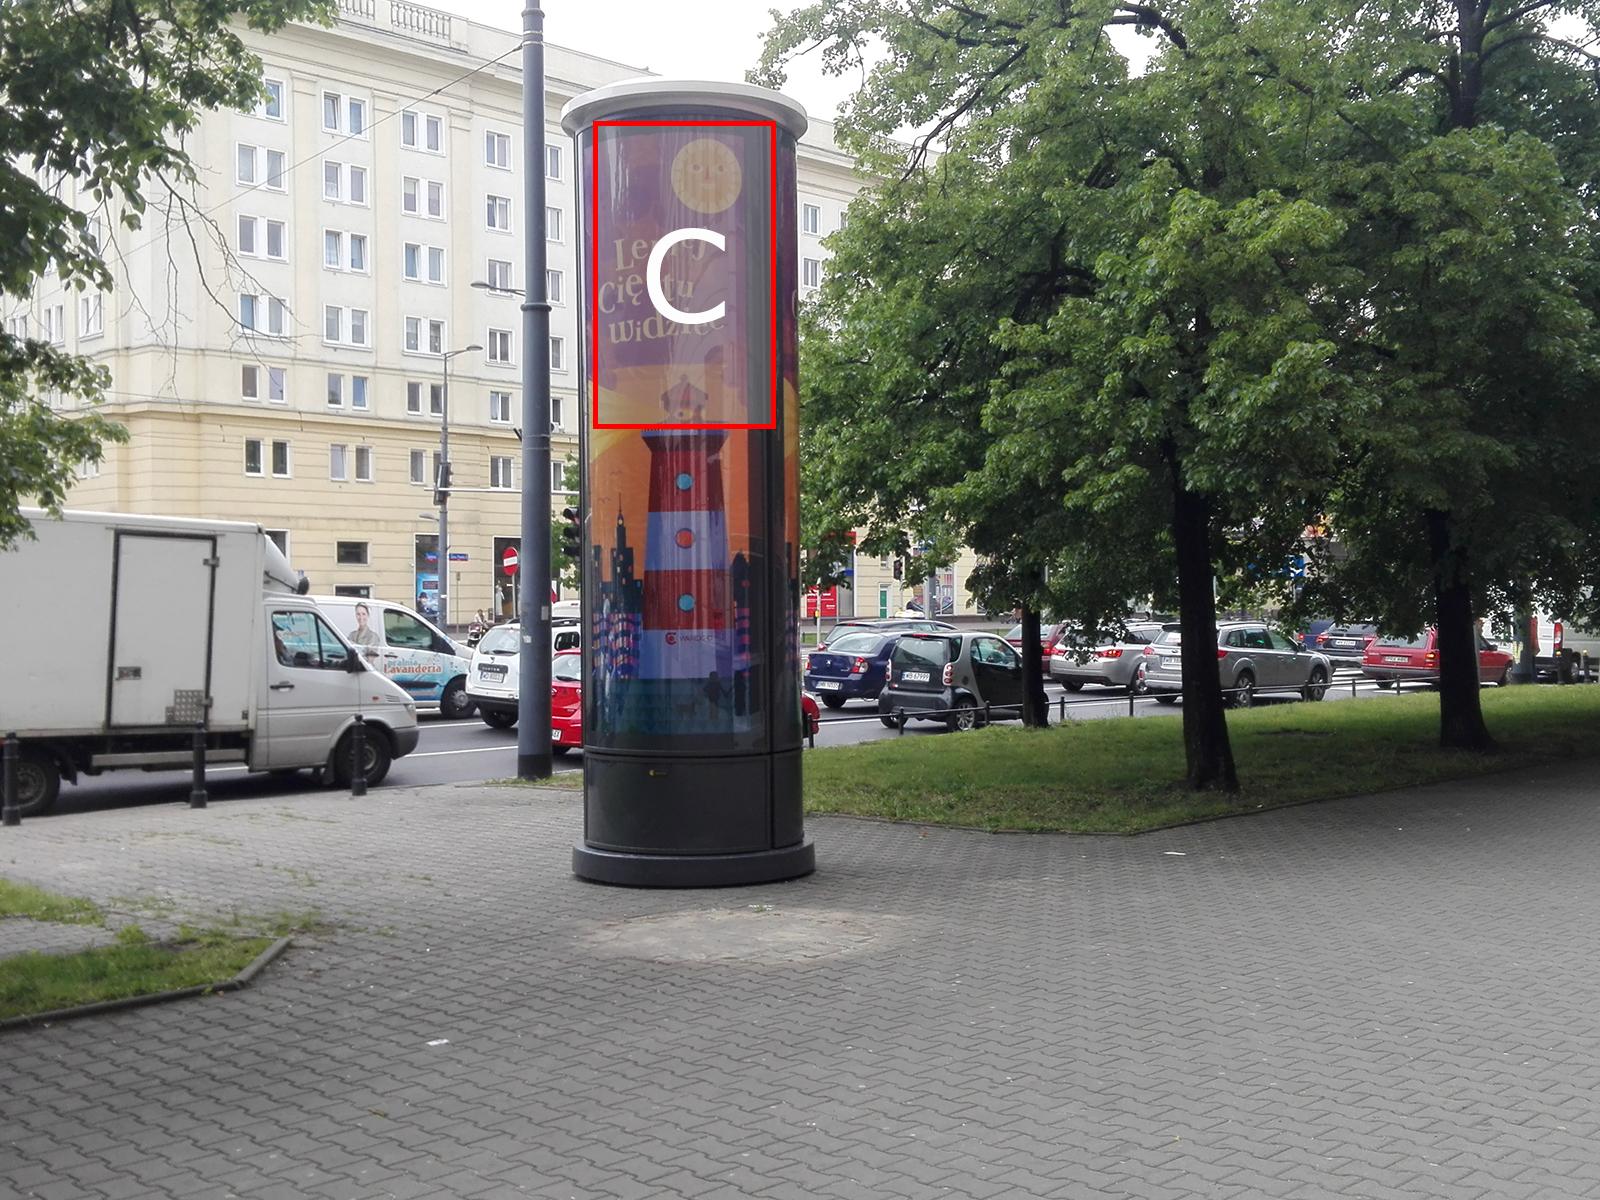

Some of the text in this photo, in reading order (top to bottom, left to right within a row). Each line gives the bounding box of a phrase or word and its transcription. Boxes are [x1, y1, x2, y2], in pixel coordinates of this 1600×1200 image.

[598, 272, 694, 314] Cię tu
[384, 663, 442, 674] Lavanderia
